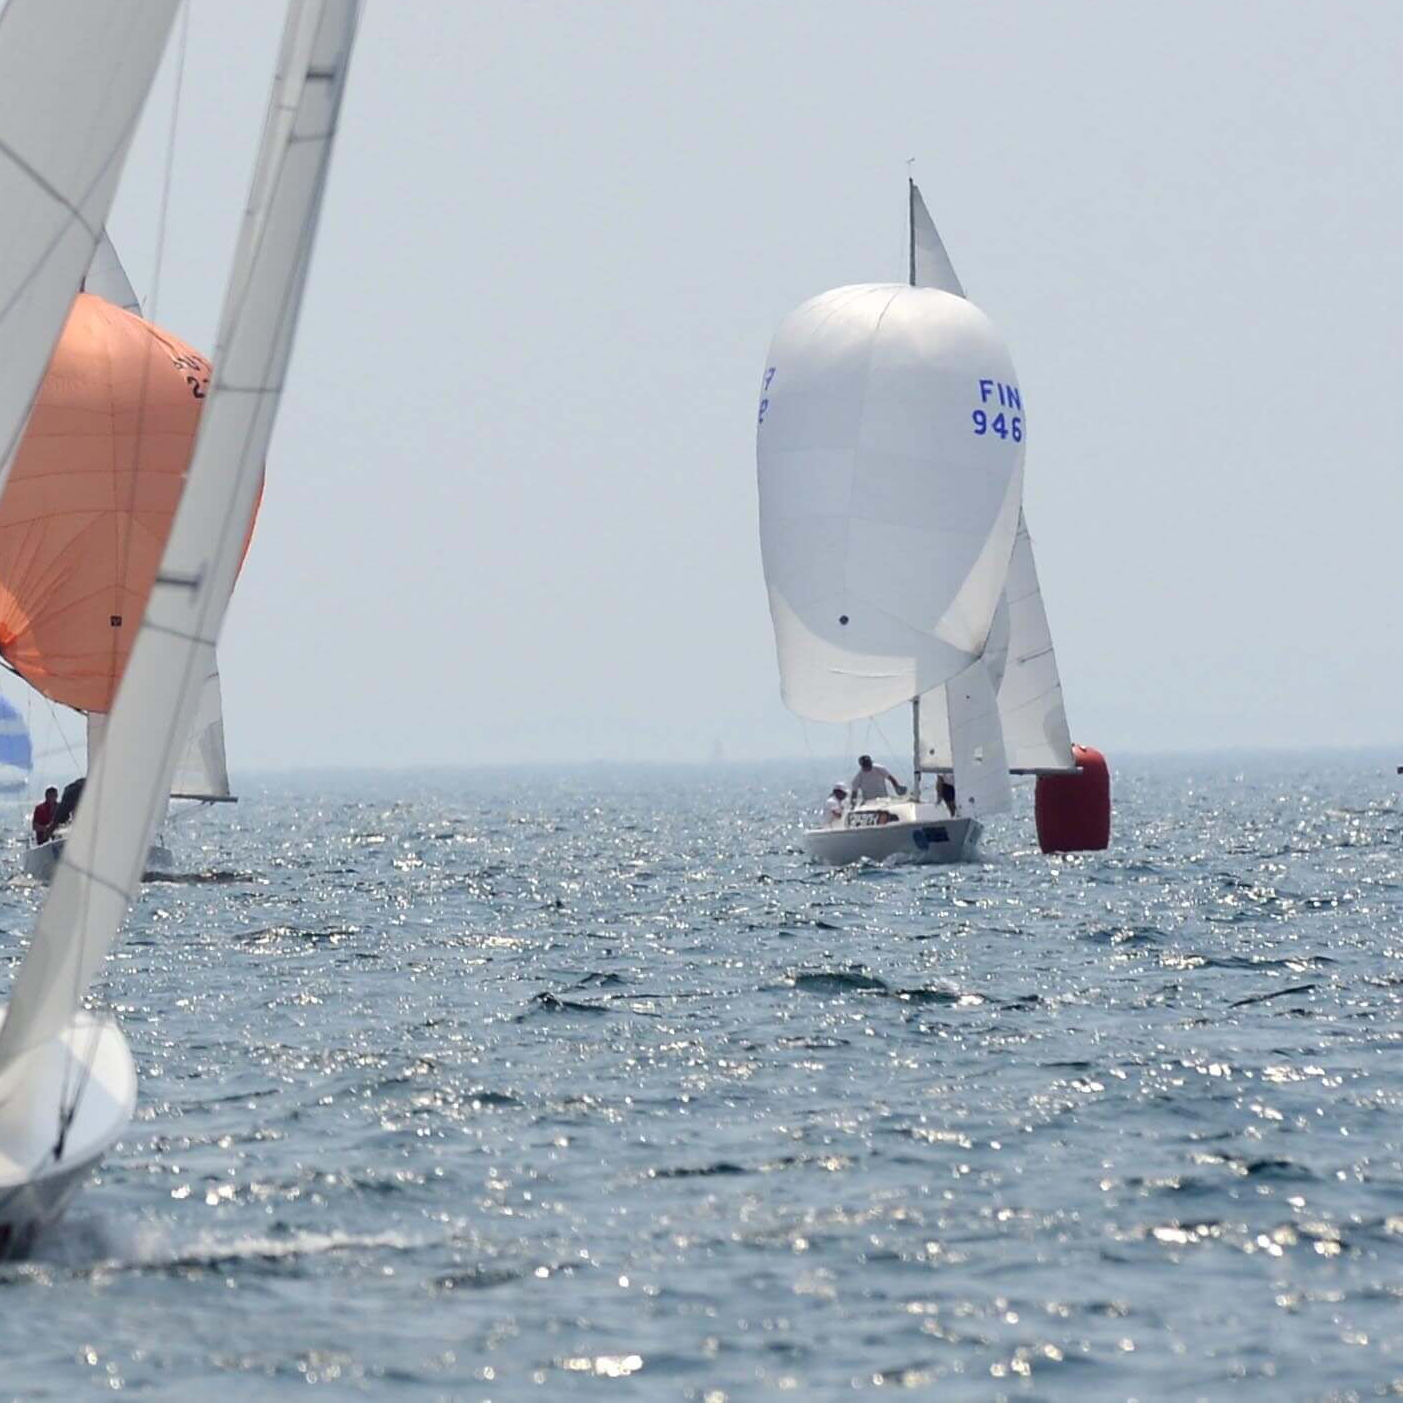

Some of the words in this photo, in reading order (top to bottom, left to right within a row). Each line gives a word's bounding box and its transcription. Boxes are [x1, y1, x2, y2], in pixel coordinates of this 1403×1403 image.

[187, 376, 208, 398] 2
[979, 379, 1021, 410] FIN
[973, 410, 1022, 442] 946
